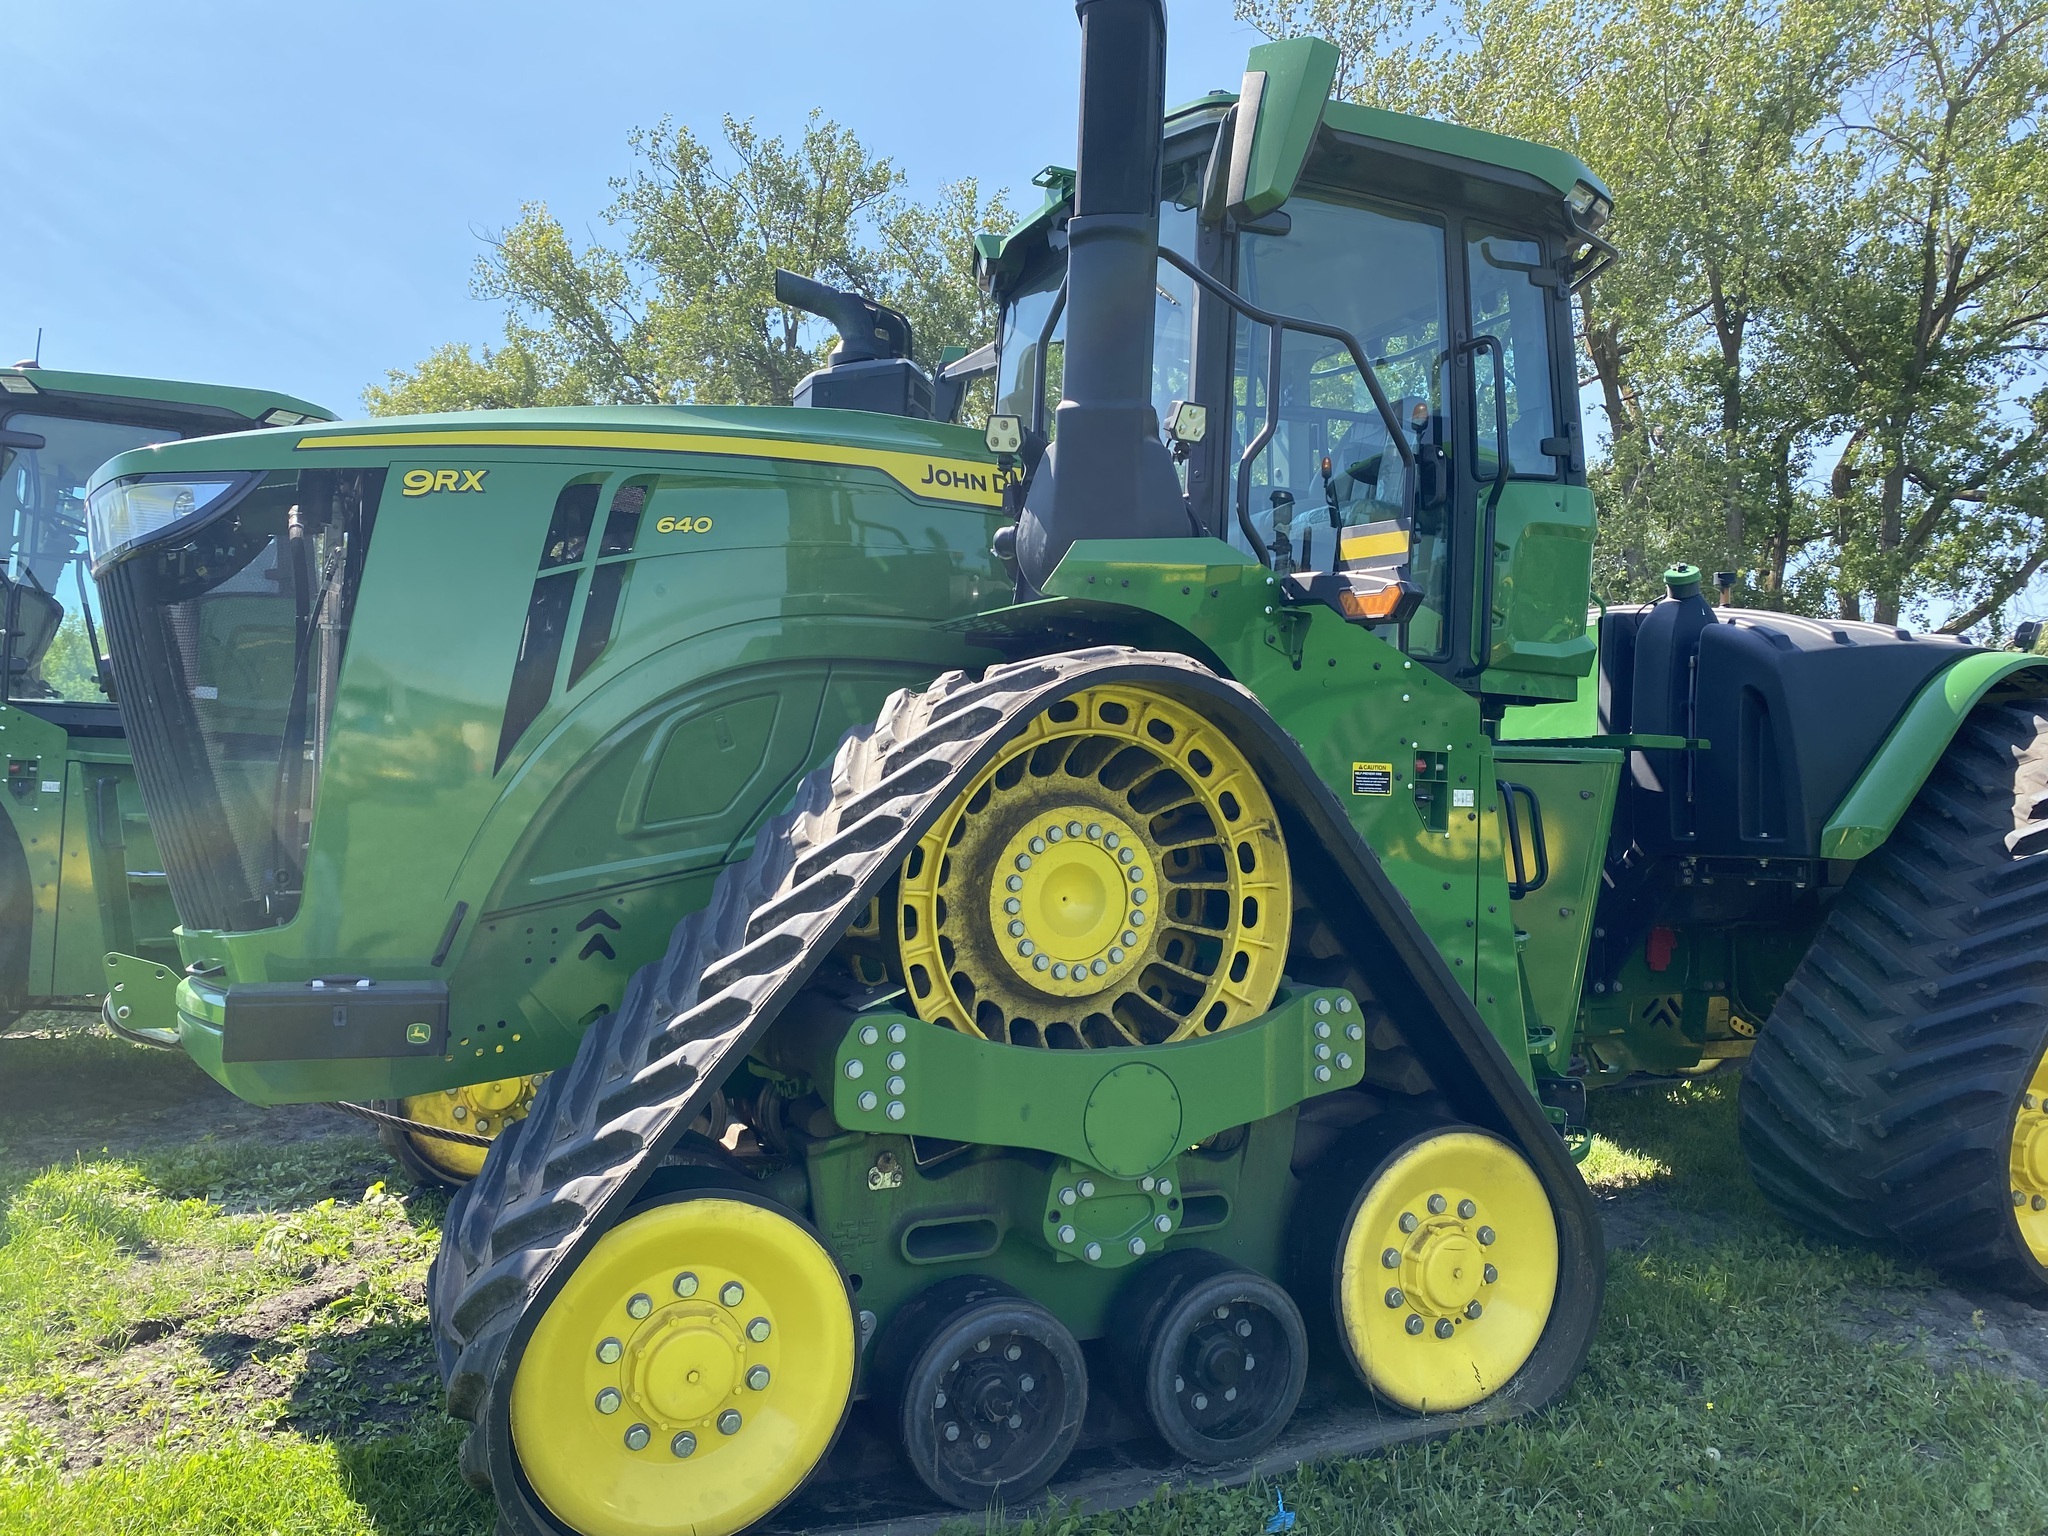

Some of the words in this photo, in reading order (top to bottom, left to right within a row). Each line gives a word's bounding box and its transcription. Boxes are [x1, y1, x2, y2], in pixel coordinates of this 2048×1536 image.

[401, 469, 488, 498] 9RX
[921, 464, 987, 492] JOHN
[656, 516, 713, 534] 640
